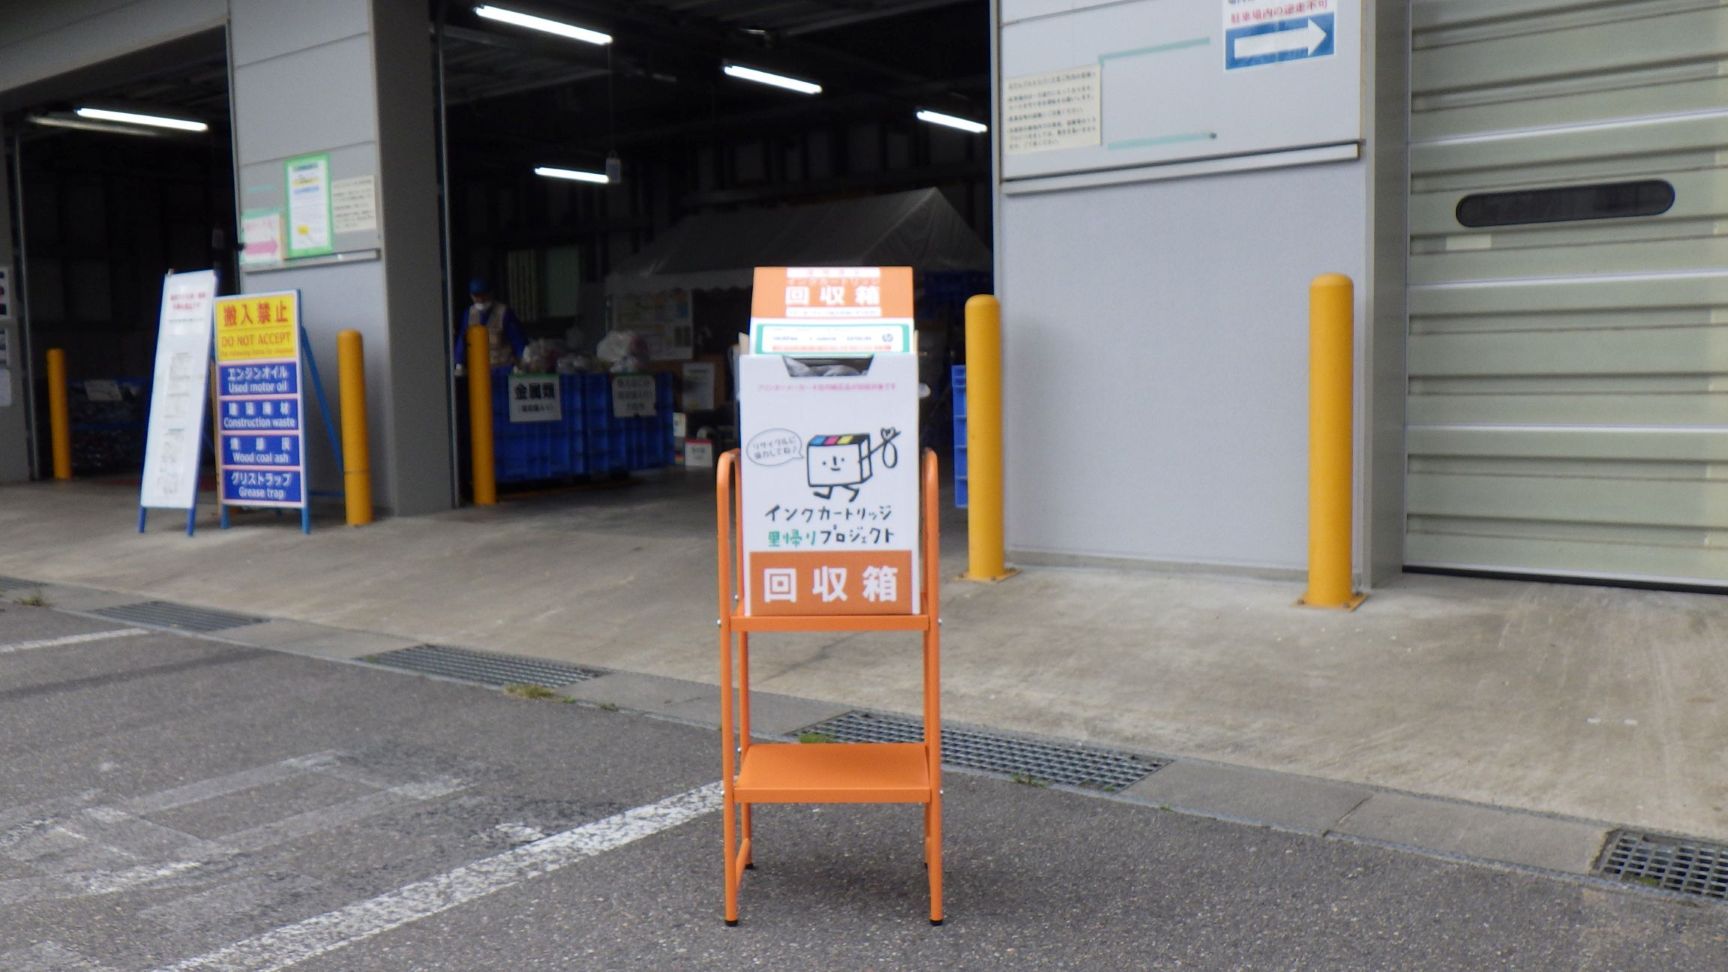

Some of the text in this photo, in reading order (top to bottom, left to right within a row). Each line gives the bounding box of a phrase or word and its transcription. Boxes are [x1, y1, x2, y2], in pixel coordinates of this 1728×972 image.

[224, 300, 289, 327] 搬入禁止
[222, 331, 291, 348] DO NOT ACCEPT
[227, 365, 289, 381] エンジンオイル
[229, 380, 287, 394] Used motor oil
[223, 417, 295, 428] Construction waste
[233, 451, 289, 464] Wood coal ash
[231, 472, 292, 487] グリストラップ
[239, 486, 285, 499] Grease trap
[764, 504, 892, 523] インクカートリッジ
[768, 523, 895, 547] 里帰りプロジェクト
[763, 565, 898, 603] 回収箱
